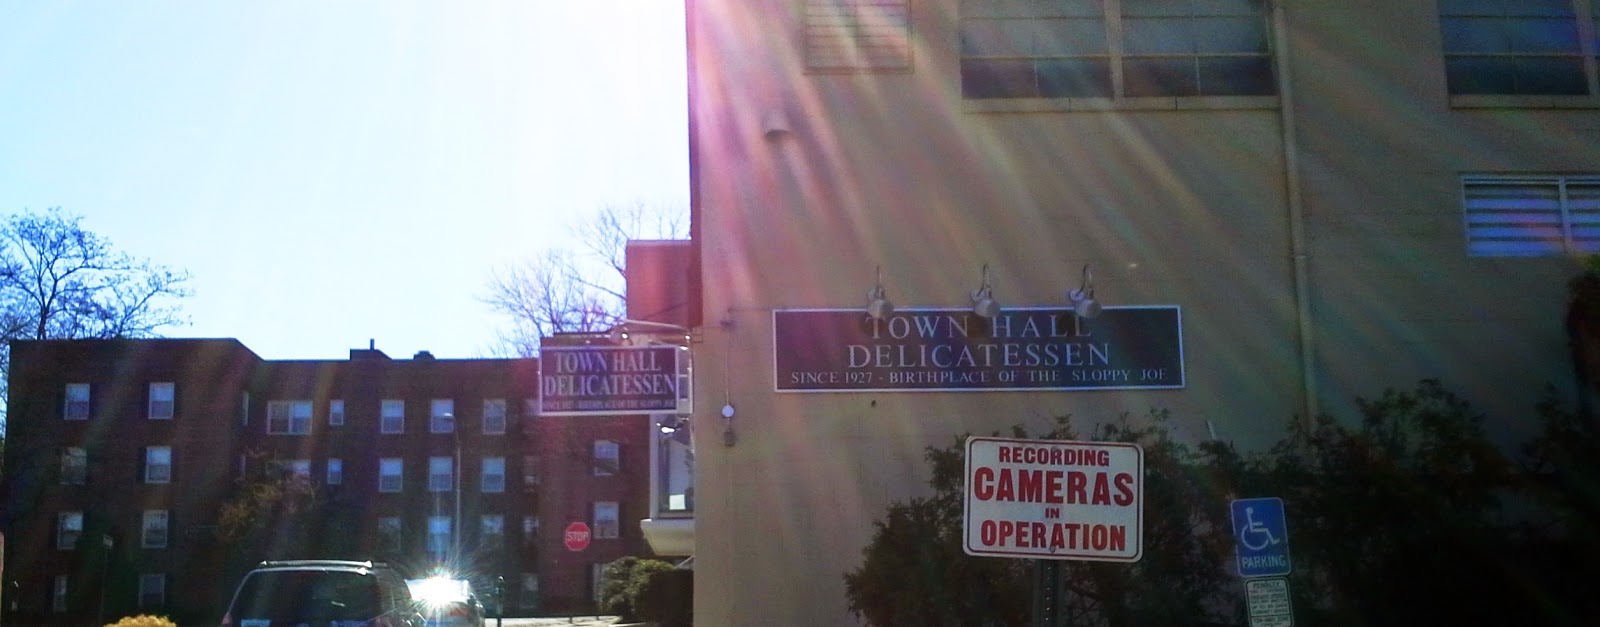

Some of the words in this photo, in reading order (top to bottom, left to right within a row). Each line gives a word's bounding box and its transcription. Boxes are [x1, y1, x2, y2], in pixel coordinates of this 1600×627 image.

[866, 315, 969, 340] TOWN
[991, 314, 1093, 338] HALL
[554, 352, 608, 373] TOWN
[613, 351, 662, 372] HALL
[848, 343, 1110, 368] DELICATESSEN
[544, 373, 677, 396] DELICATESSEN
[791, 371, 839, 384] SINCE
[844, 371, 873, 384] 1927
[889, 371, 990, 384] BIRTHPLACE
[998, 370, 1019, 382] OF
[1029, 370, 1061, 382] THE
[1072, 369, 1131, 382] SLOPPY
[1140, 369, 1169, 381] JOE
[998, 446, 1110, 467] RECORDING
[973, 467, 1134, 507] CAMERAS
[1044, 508, 1060, 519] IN
[567, 531, 588, 542] STOP
[980, 519, 1125, 552] OPERATION
[1241, 554, 1286, 569] PARKING
